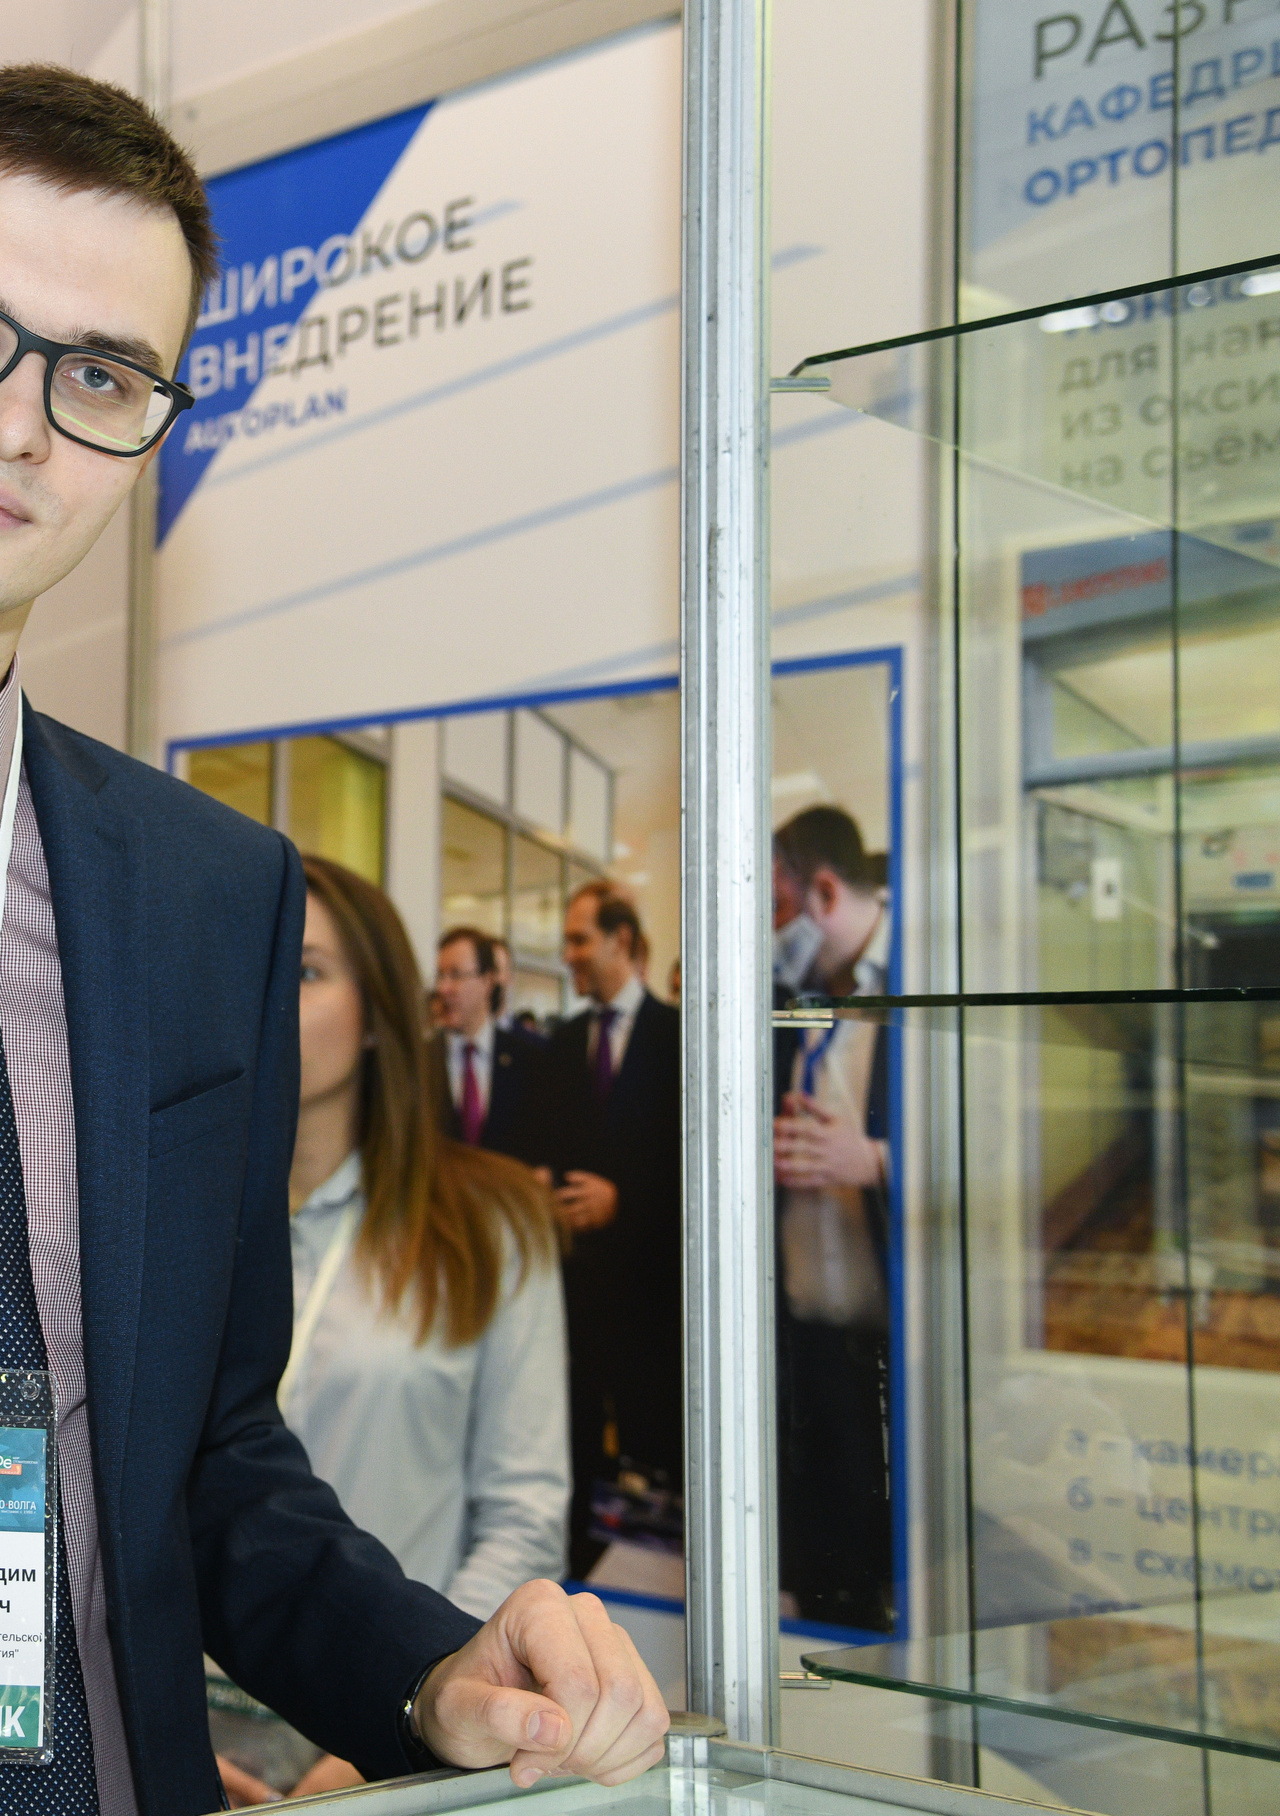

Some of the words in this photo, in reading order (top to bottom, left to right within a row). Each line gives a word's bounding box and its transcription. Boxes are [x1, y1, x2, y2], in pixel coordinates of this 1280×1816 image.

[1025, 38, 1280, 147] КАФЕДР
[195, 196, 477, 330] ШИРОКОЕ
[188, 256, 534, 401] ВНЕДРЕНИЕ
[1058, 340, 1161, 397] для
[184, 388, 349, 454] AUTOPLAN
[1061, 401, 1123, 442] из
[1061, 453, 1125, 488] на
[1135, 1494, 1280, 1542] центр
[1134, 1548, 1280, 1593] схемо
